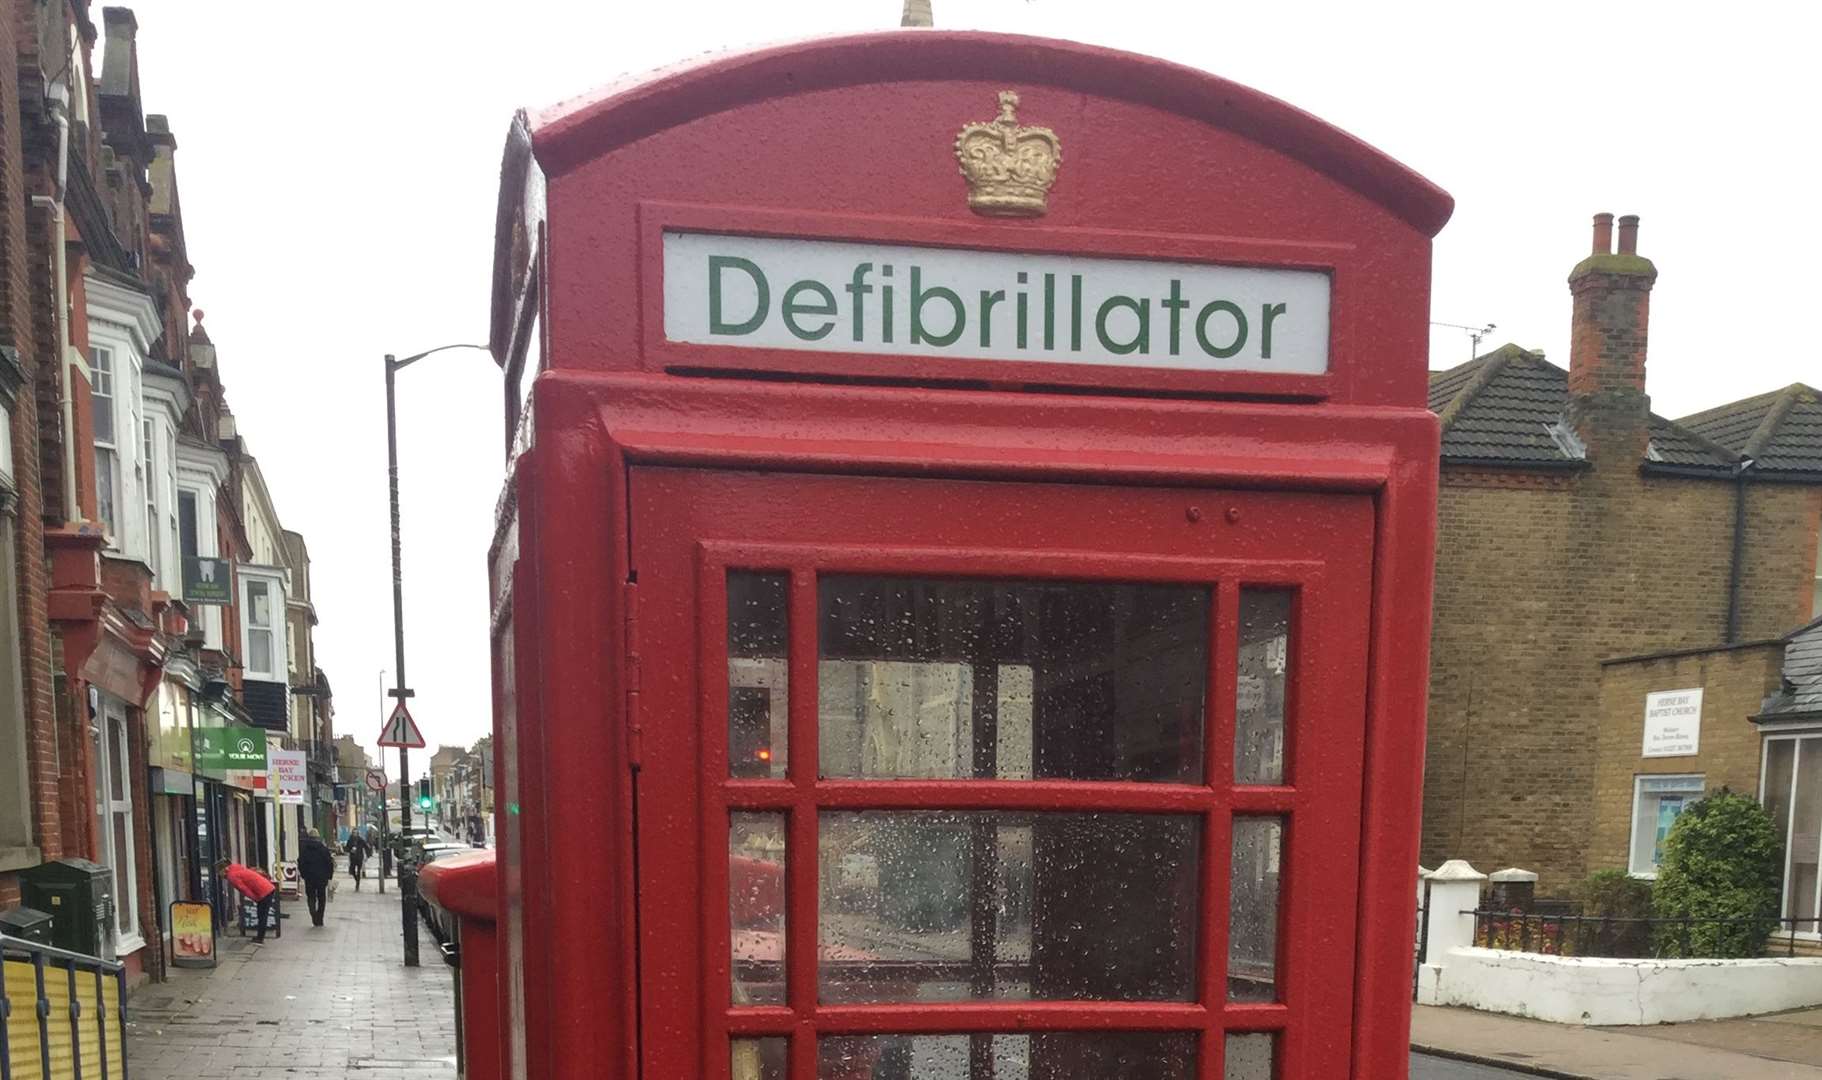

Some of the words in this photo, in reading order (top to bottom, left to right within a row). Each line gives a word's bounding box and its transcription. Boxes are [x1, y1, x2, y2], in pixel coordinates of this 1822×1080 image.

[708, 255, 1287, 359] Defibrillator
[1649, 707, 1671, 718] BAPTIST
[1672, 705, 1697, 716] CHURCH
